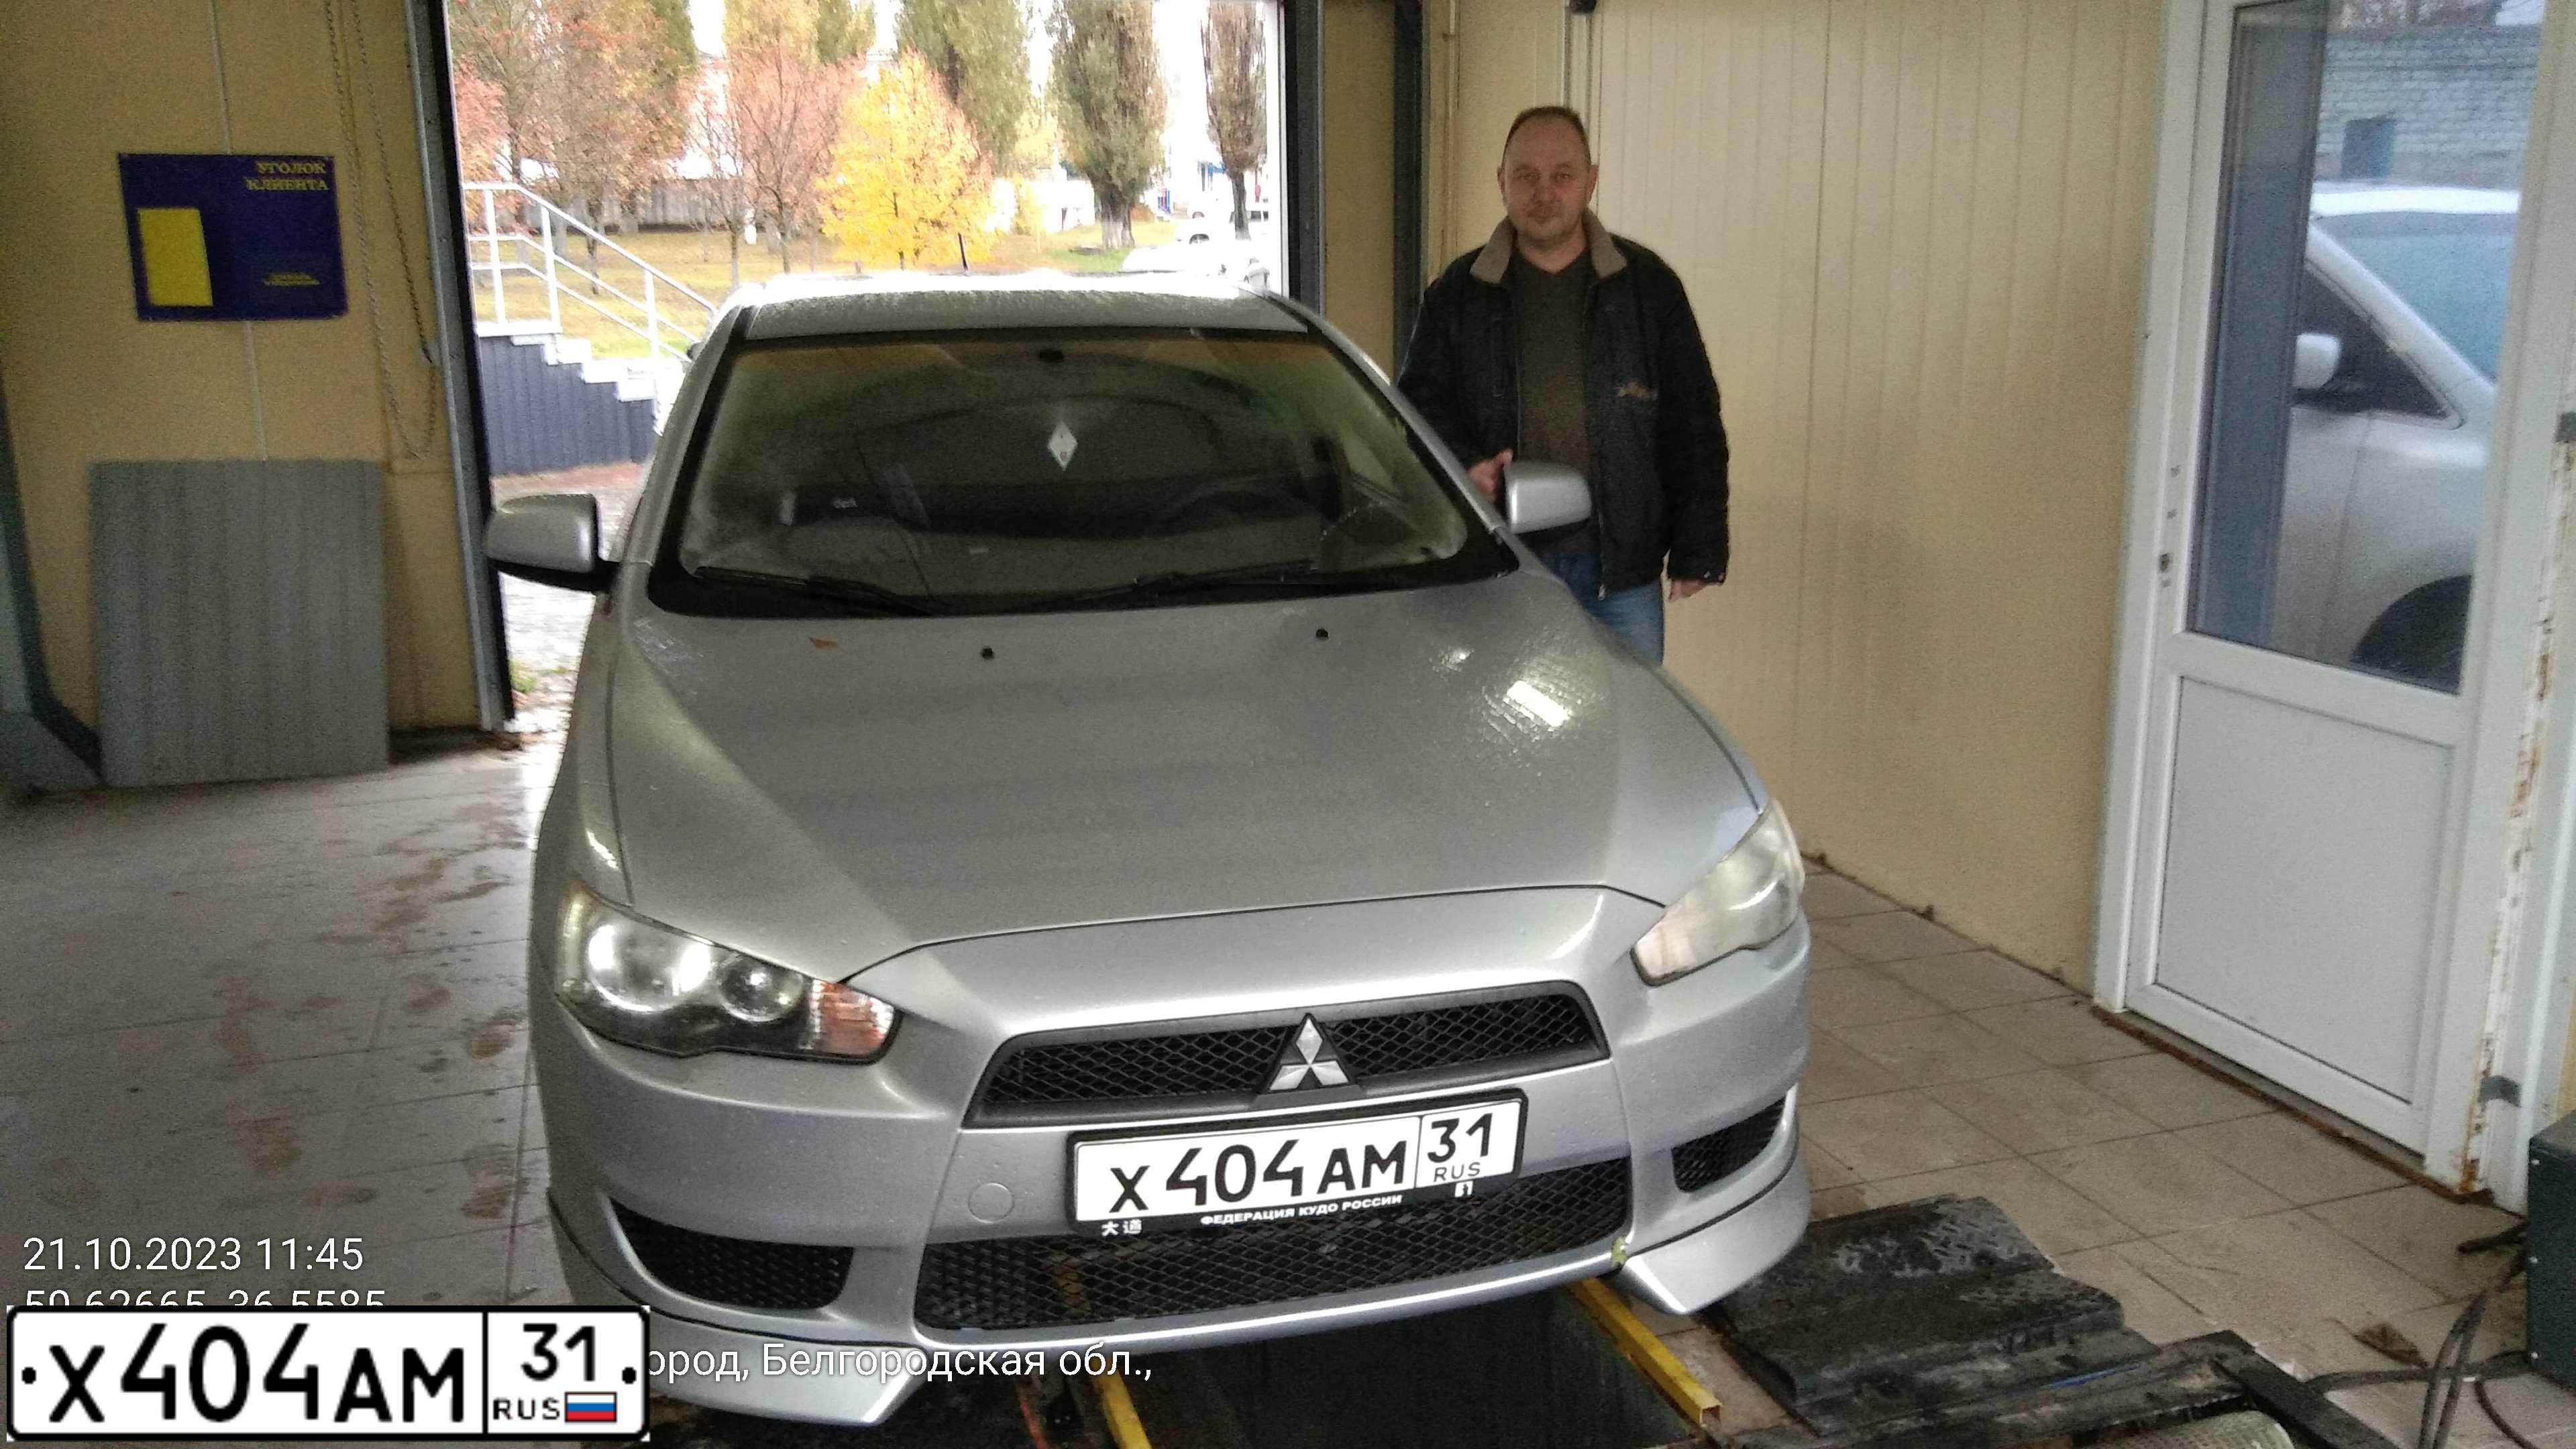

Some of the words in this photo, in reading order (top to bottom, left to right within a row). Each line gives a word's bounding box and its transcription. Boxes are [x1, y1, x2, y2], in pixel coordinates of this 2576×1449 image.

[246, 178, 329, 191] КЛИЕНТА
[1427, 1112, 1493, 1163] 31
[1433, 1161, 1481, 1183] RUS
[1200, 1208, 1295, 1226] ФЕДЕРАЦИЯ
[1298, 1202, 1338, 1218] КУДО
[1342, 1194, 1403, 1212] РОССИИ
